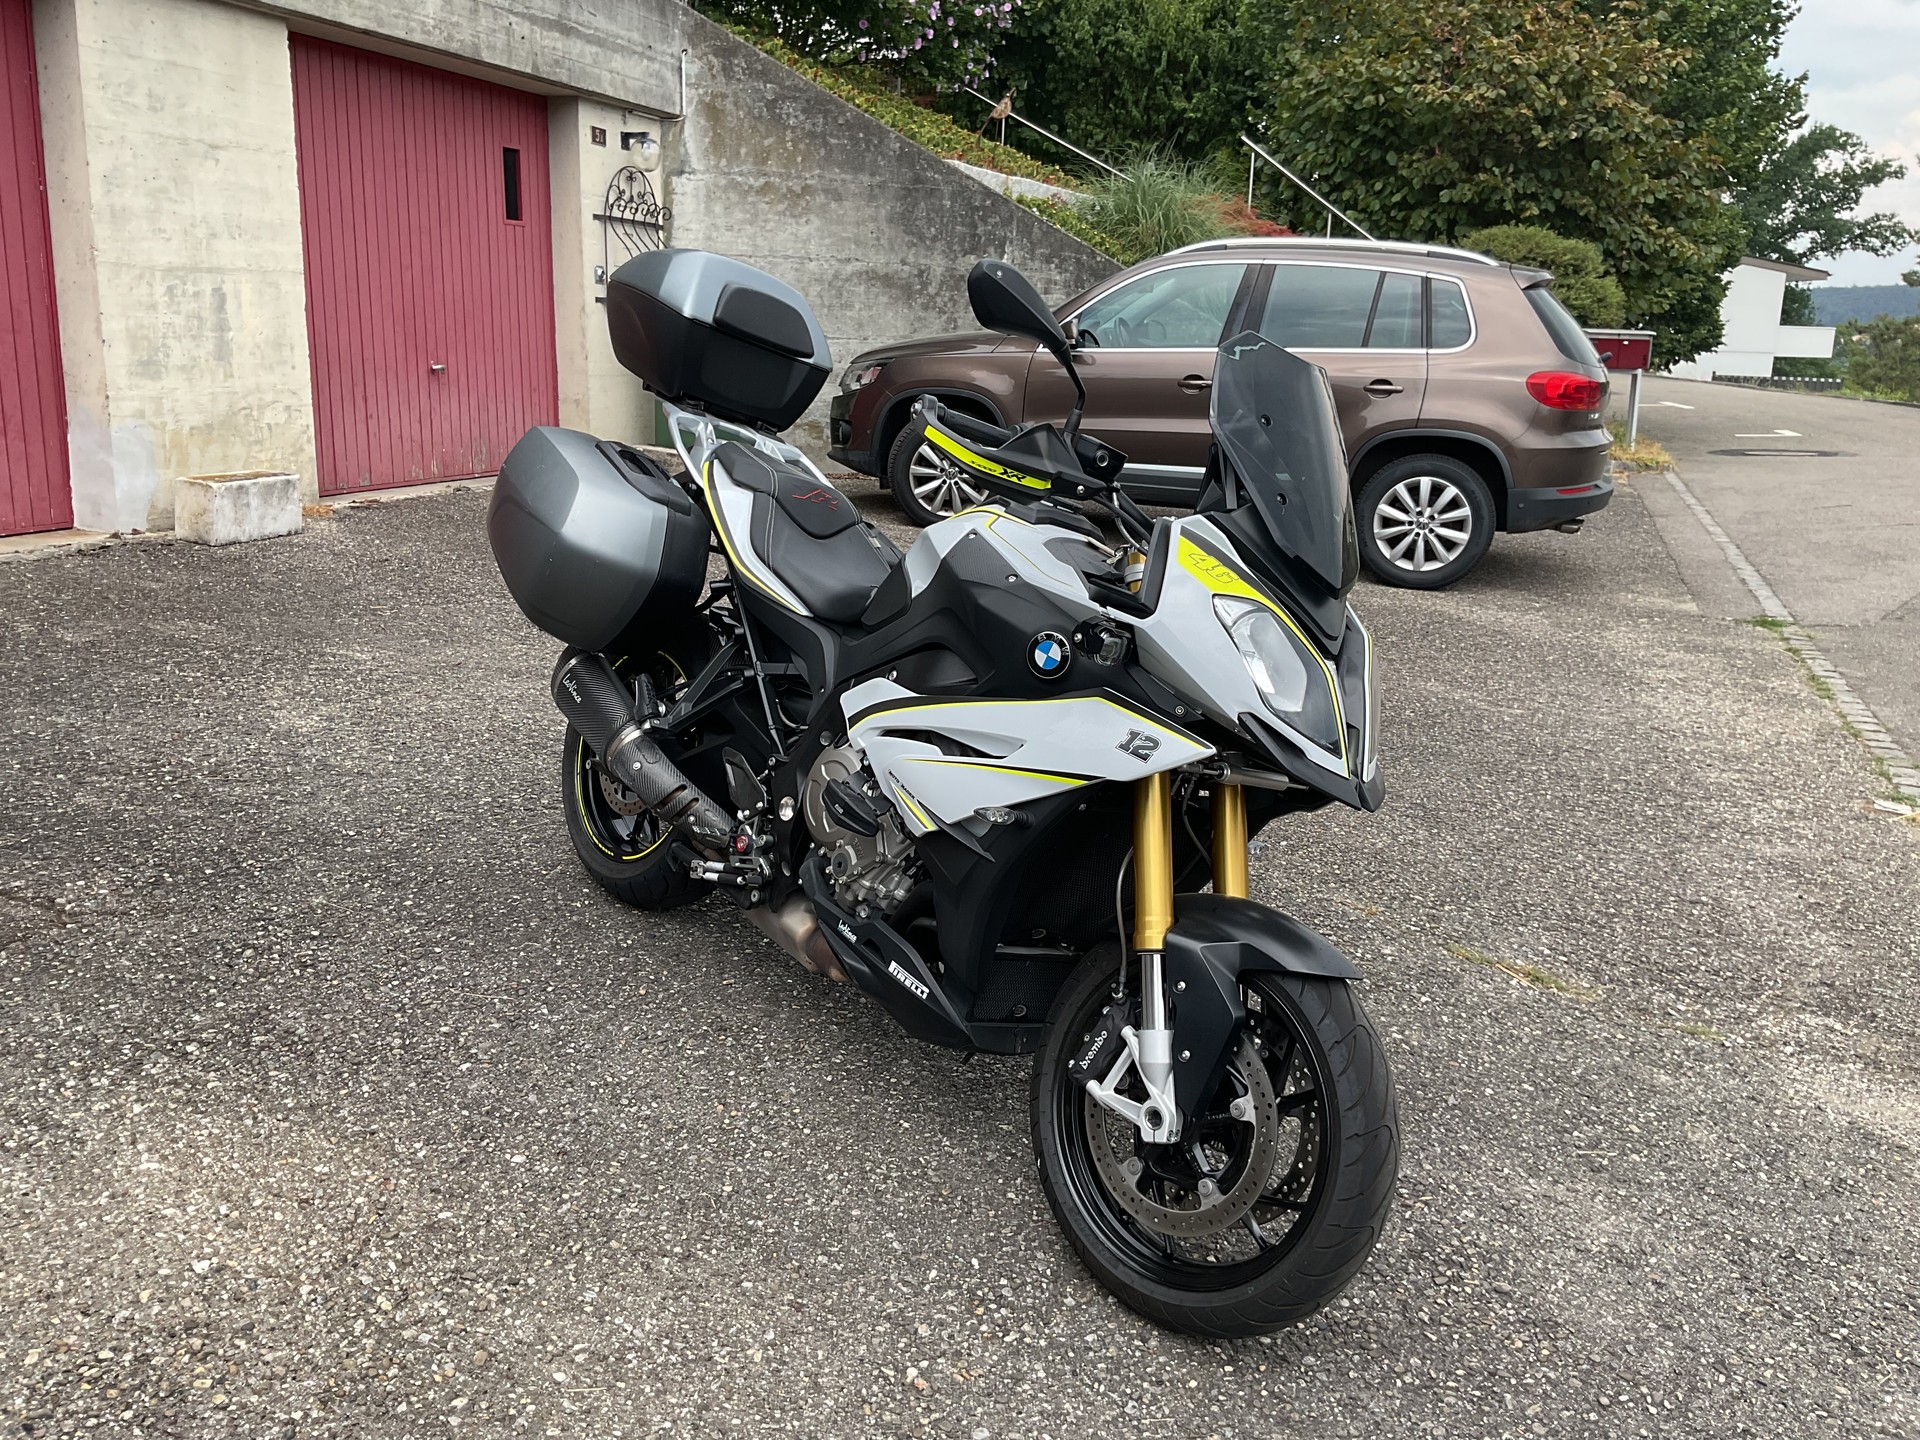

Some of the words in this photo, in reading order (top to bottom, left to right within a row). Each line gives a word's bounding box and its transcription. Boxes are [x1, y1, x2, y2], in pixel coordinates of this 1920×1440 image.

[997, 466, 1028, 483] XR
[1188, 552, 1239, 584] 46
[1037, 633, 1070, 656] BMW
[1115, 727, 1162, 764] 12
[887, 959, 930, 1000] PIRELLI
[1078, 1030, 1108, 1070] brembo
